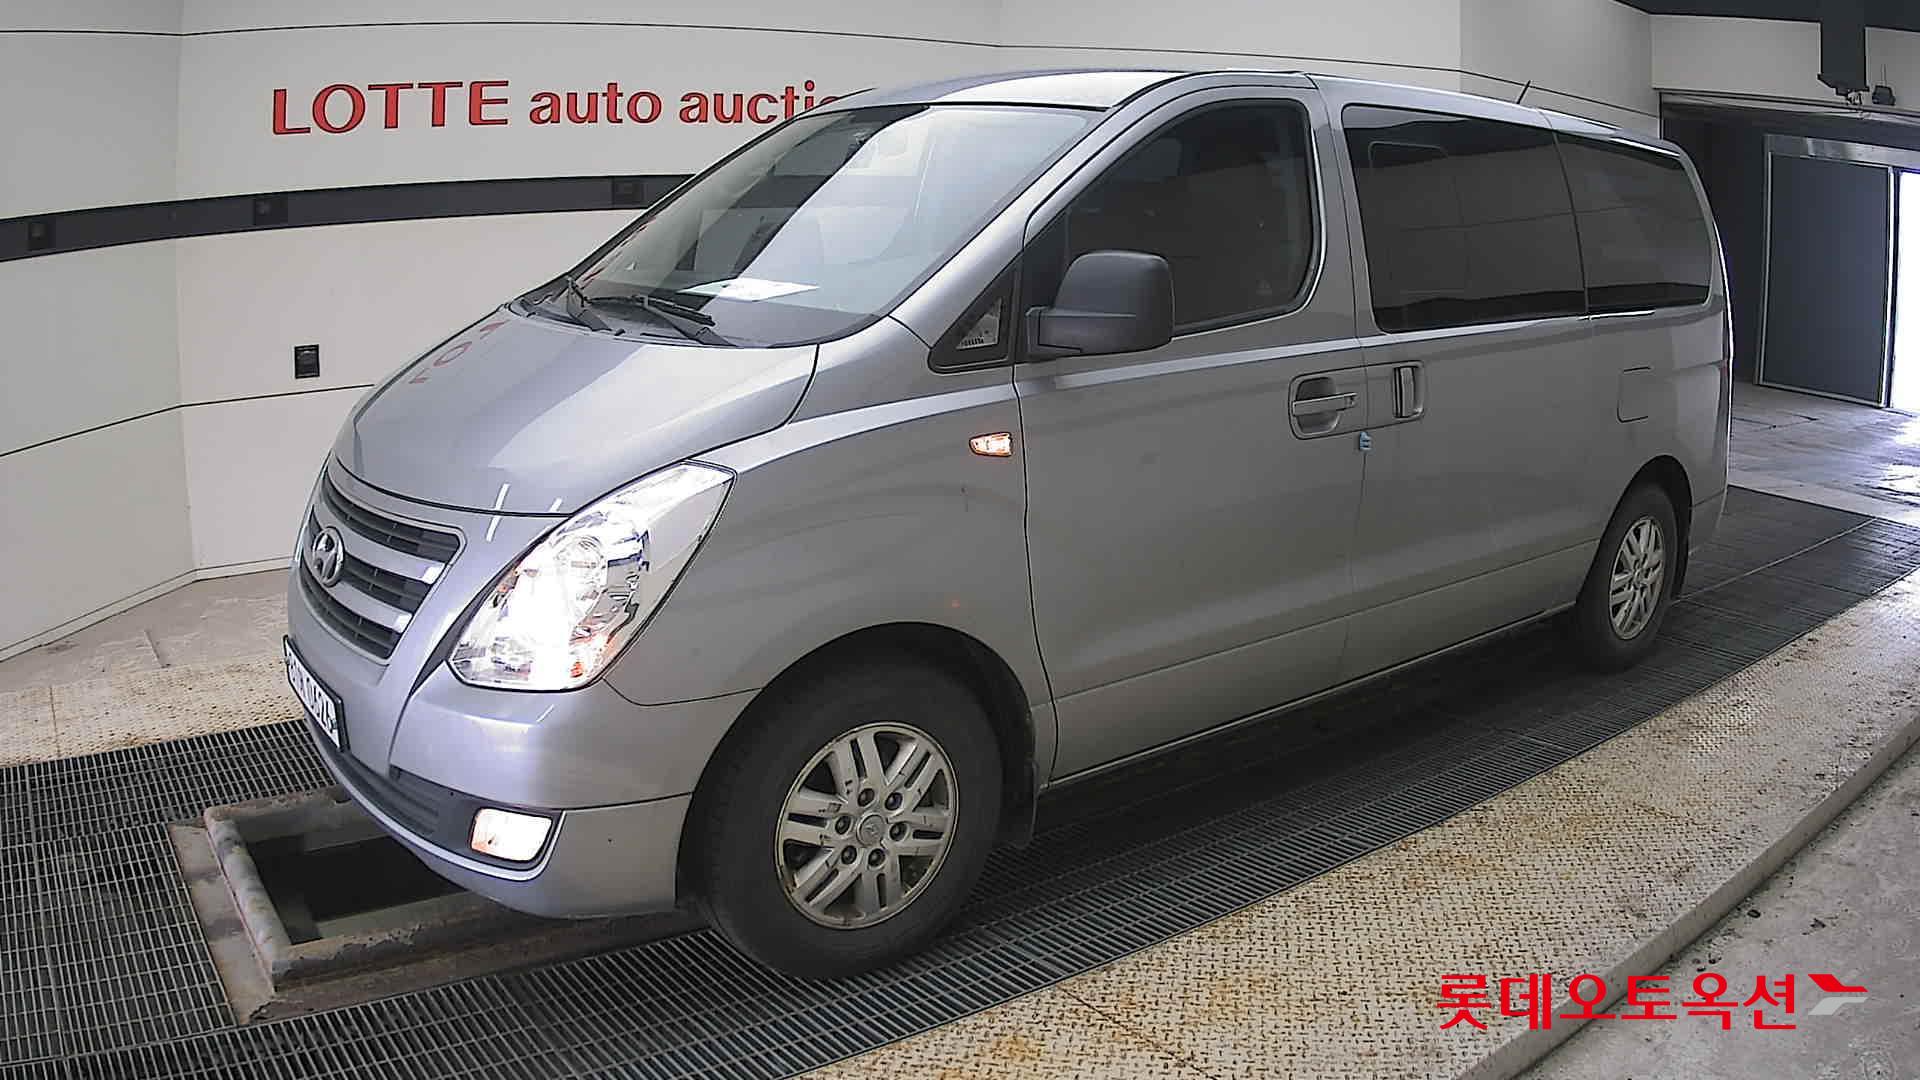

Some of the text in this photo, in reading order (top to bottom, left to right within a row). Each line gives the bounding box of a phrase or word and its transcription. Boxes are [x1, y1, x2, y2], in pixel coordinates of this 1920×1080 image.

[272, 80, 840, 135] LOTTE auto aucti
